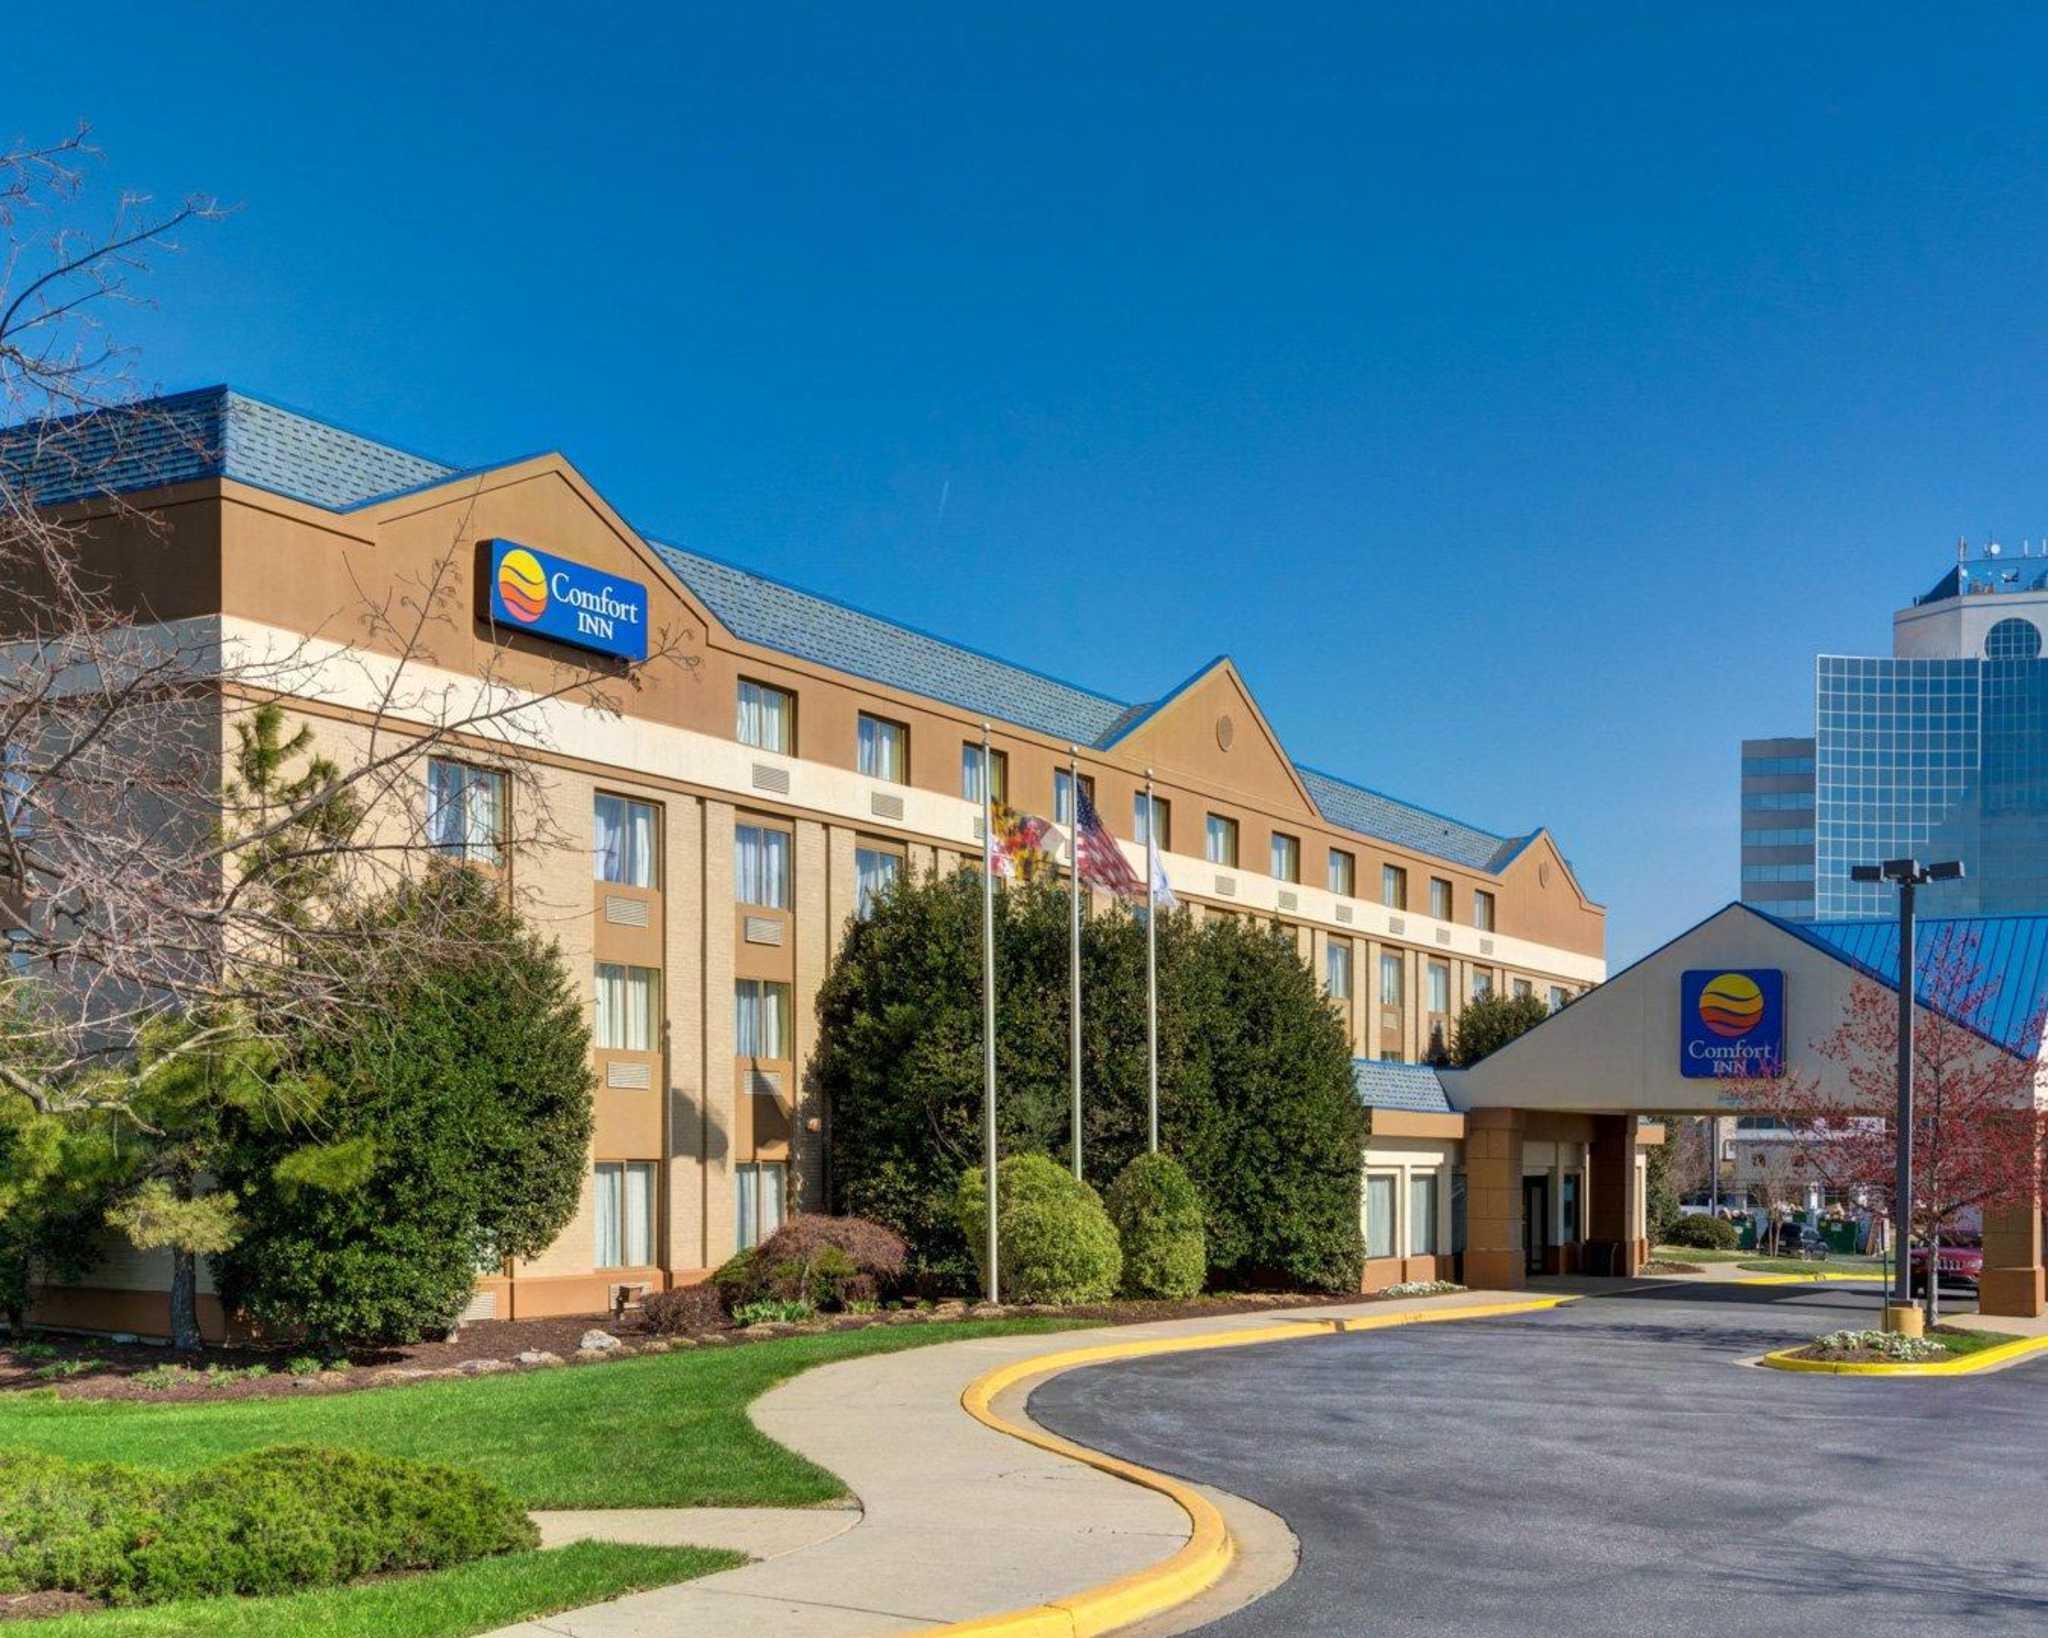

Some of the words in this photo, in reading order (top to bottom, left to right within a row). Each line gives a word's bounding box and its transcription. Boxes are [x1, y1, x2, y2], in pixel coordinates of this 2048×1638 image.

[552, 573, 638, 624] Comfort
[578, 611, 613, 640] INN
[1688, 1040, 1772, 1060] Comfort
[1712, 1060, 1747, 1074] INN
